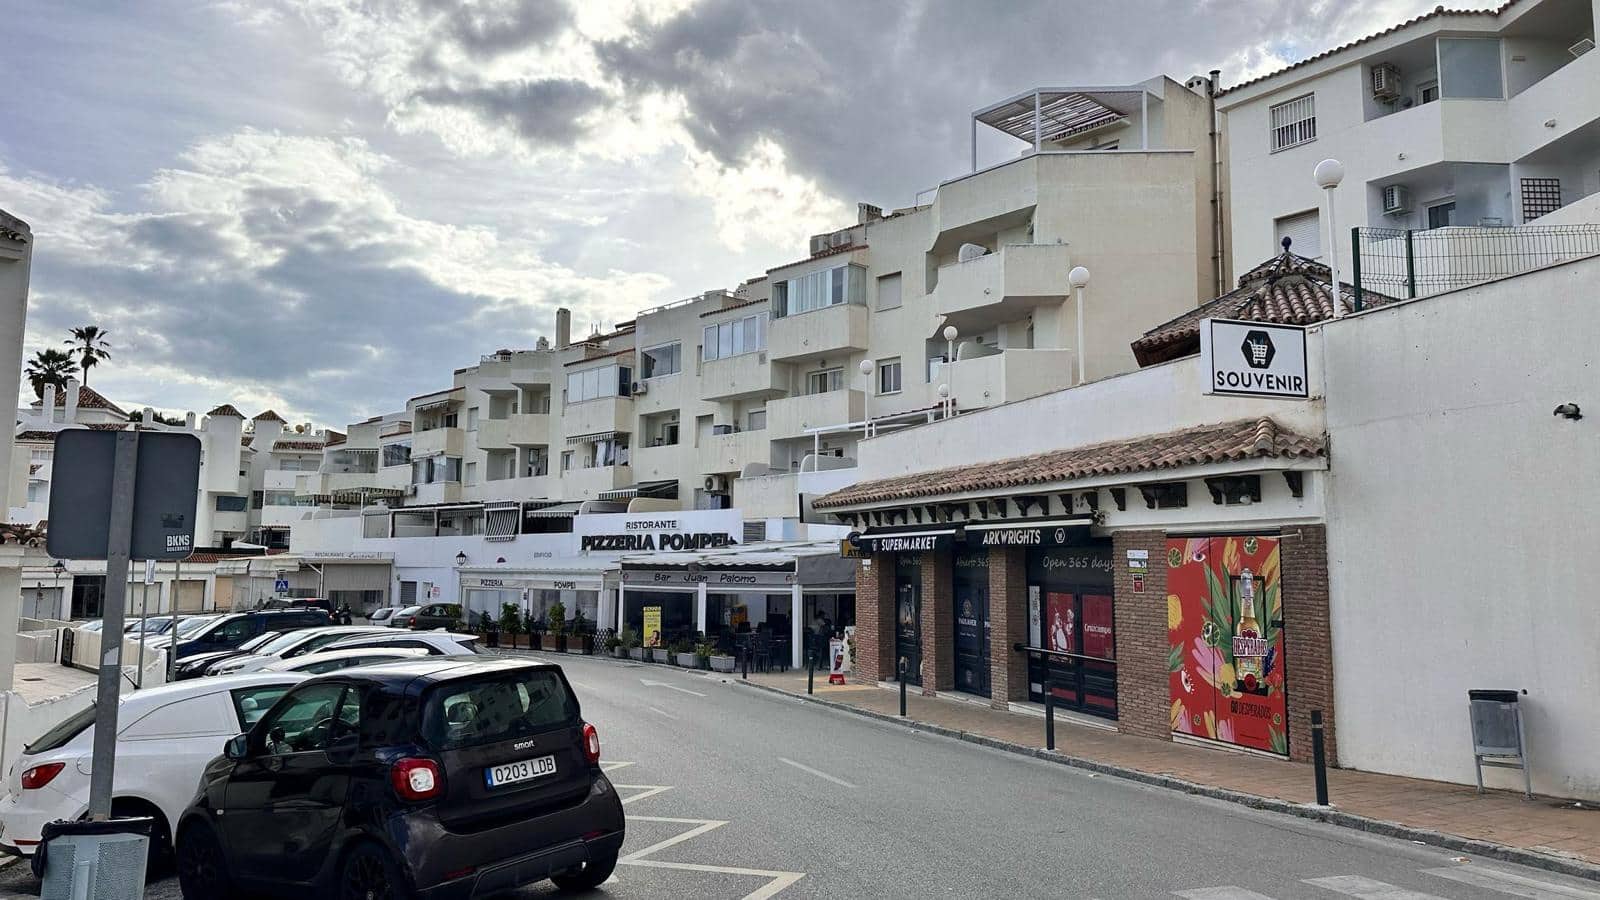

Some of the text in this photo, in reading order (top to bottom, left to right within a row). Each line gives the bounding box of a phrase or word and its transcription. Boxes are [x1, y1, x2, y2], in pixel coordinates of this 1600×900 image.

[1217, 370, 1303, 392] SOUVENIR
[626, 520, 677, 530] RISTORANTE
[166, 535, 190, 546] BKNS
[581, 533, 729, 551] PIZZERIA POMPEI
[881, 536, 937, 552] SUPERMARKET
[982, 529, 1041, 545] ARKWRIGHTS
[1042, 556, 1067, 571] Open
[1068, 557, 1088, 568] 365
[1091, 555, 1114, 572] days
[480, 578, 504, 587] PIZZERIA
[554, 581, 576, 589] POMPEI
[654, 573, 757, 583] Bar Juan Palomo
[1084, 623, 1112, 634] Cruzcampo
[1233, 637, 1268, 656] DESPERADOS
[1239, 703, 1272, 719] DESPERADOS
[514, 740, 535, 751] smart
[495, 758, 554, 782] 0203 LDB
